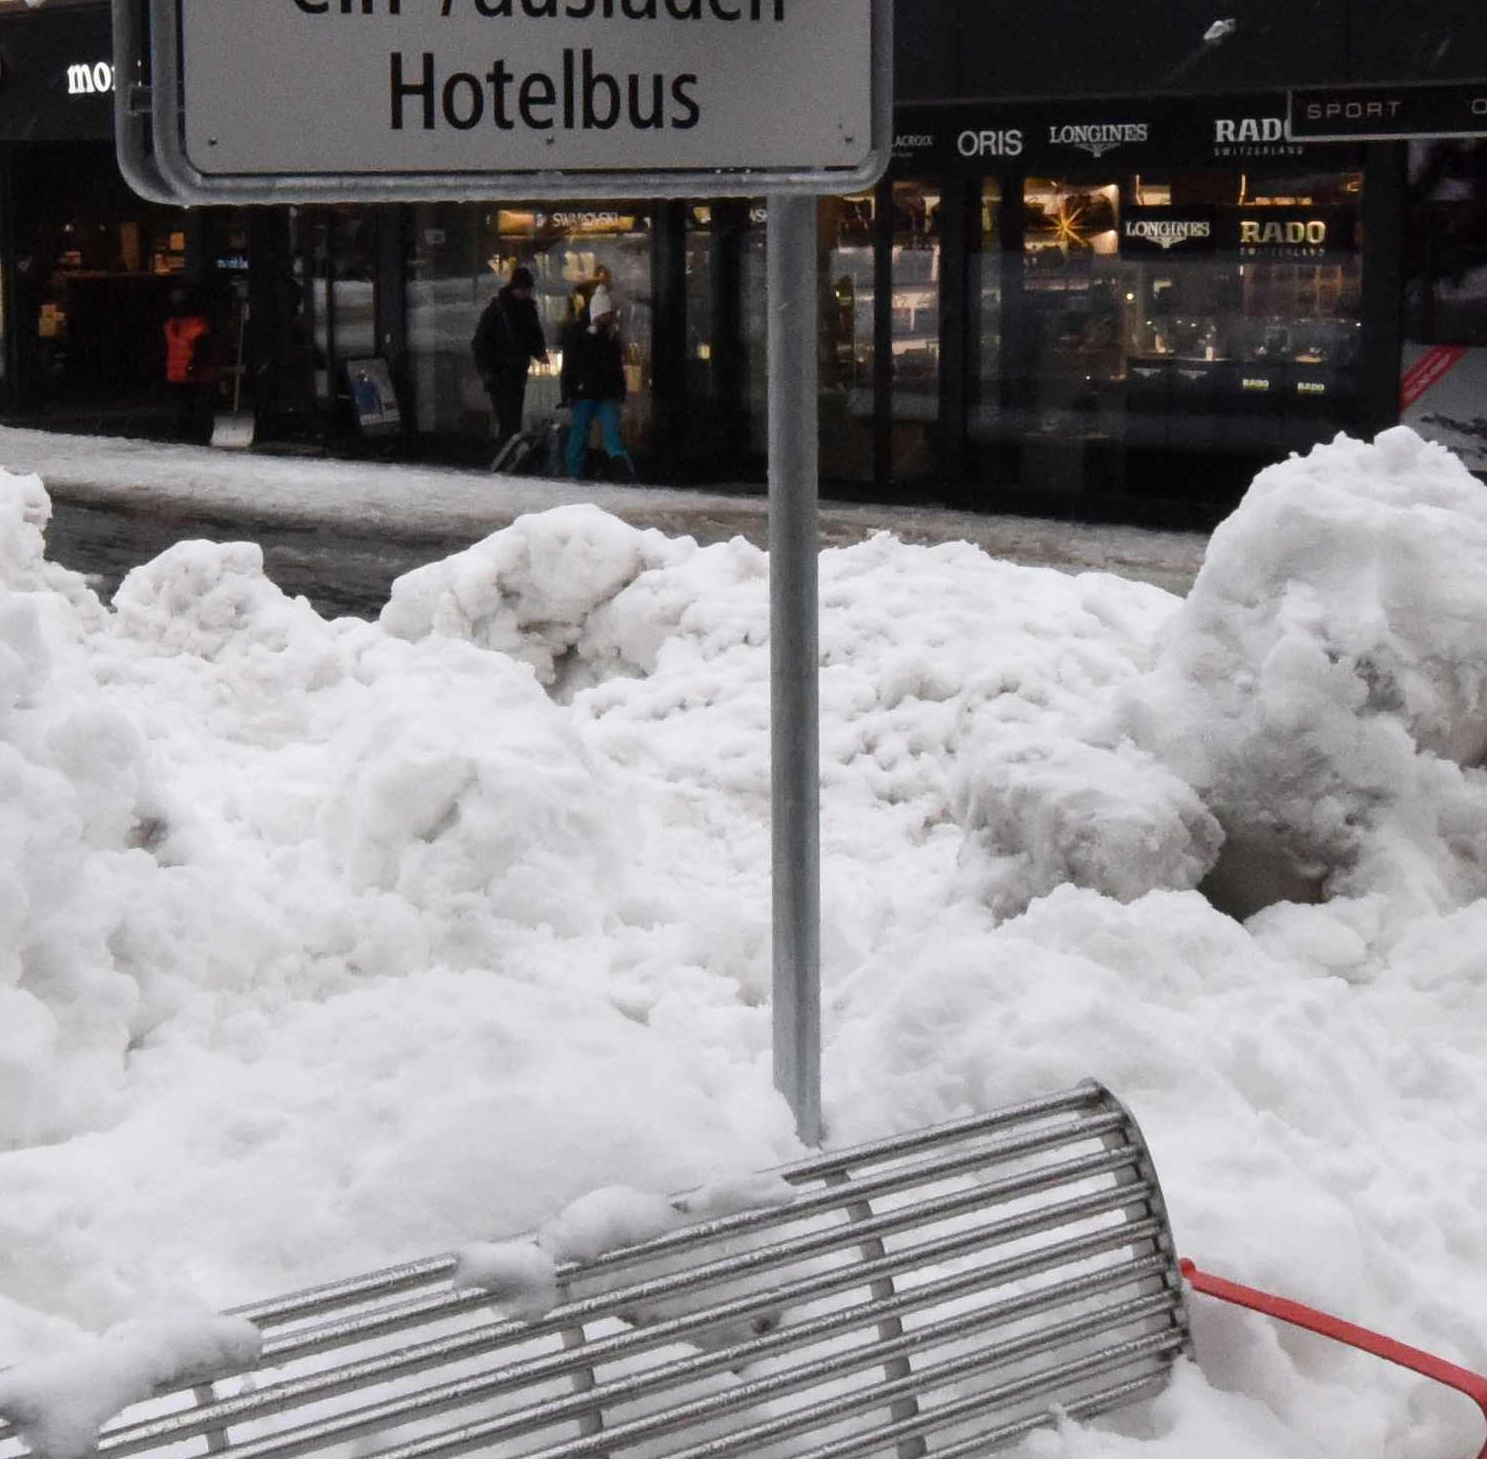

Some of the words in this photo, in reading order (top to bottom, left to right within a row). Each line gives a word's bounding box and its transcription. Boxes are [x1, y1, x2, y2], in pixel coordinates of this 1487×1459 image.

[390, 48, 701, 130] Hotelbus
[1307, 101, 1402, 119] SPORT
[958, 130, 1023, 156] ORIS
[1049, 124, 1149, 144] LONGINES
[1126, 221, 1210, 237] LONGINES
[1239, 220, 1326, 244] RADO
